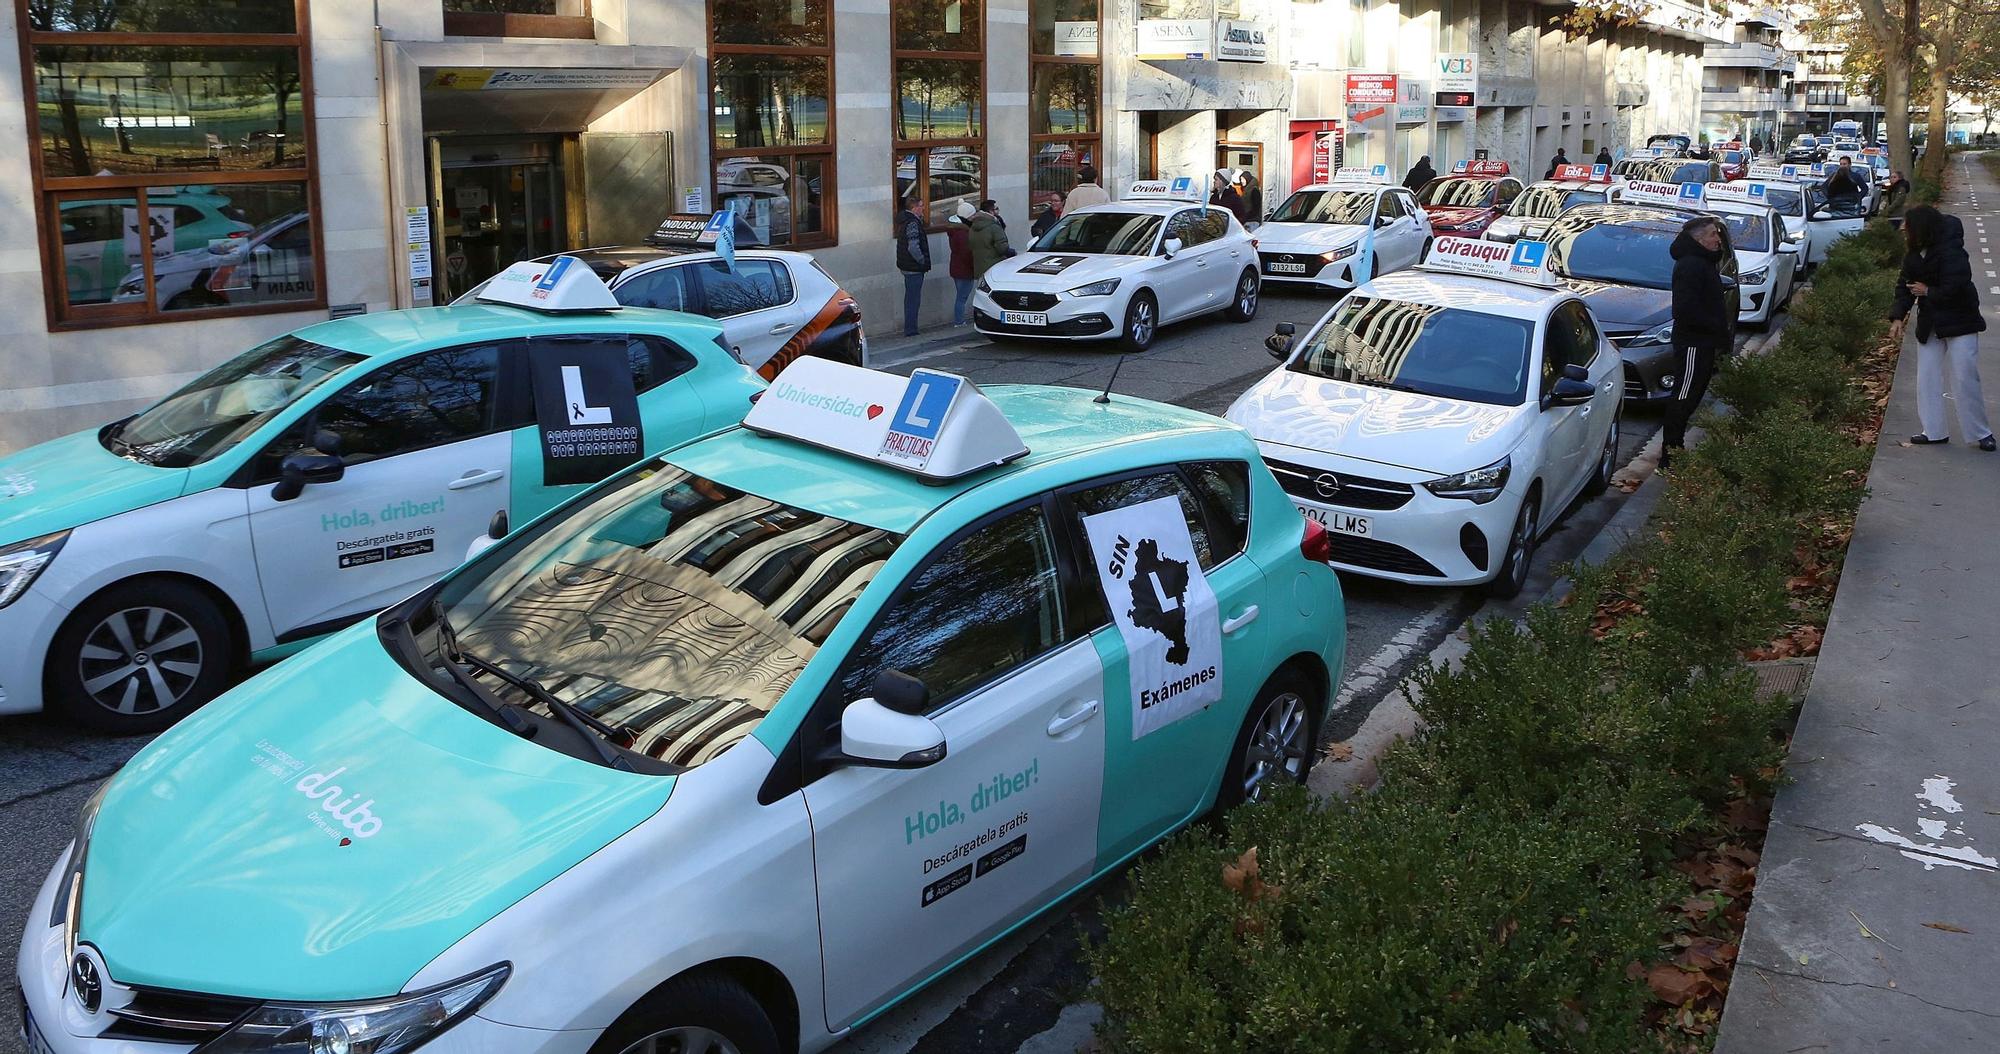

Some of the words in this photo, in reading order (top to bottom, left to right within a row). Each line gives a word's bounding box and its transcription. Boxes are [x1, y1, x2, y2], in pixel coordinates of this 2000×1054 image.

[1152, 25, 1194, 37] ASENA
[1348, 88, 1394, 97] CONDUCTORES
[1594, 166, 1602, 174] L
[1132, 183, 1167, 193] Orvina
[1175, 181, 1184, 190] L
[1629, 180, 1679, 197] Cirauqui
[1685, 185, 1696, 197] L
[1708, 182, 1747, 193] Cirauqui
[1751, 185, 1761, 195] L
[660, 219, 708, 231] INDURAIN
[711, 214, 722, 229] L
[1436, 237, 1511, 263] Cirauqui
[1518, 245, 1534, 263] L
[1272, 263, 1289, 271] 2132
[1290, 264, 1304, 272] LSG
[1006, 313, 1026, 323] 8894
[1028, 315, 1044, 324] LPF
[561, 365, 613, 426] L
[775, 381, 868, 419] Universidad
[905, 382, 930, 428] L
[883, 430, 934, 459] PRACTICAS
[320, 508, 376, 532] Hola,
[380, 495, 445, 522] driber!
[1334, 513, 1367, 534] LMS
[336, 531, 405, 551] Descárgatela
[407, 525, 435, 541] gratis
[1108, 534, 1131, 580] SIN
[1148, 571, 1179, 614] L
[1140, 665, 1216, 711] Exámenes
[295, 766, 383, 839] dribo
[904, 800, 966, 846] Hola,
[970, 757, 1039, 814] driber!
[923, 828, 996, 875] Descárgatela
[999, 811, 1029, 838] gratis
[935, 884, 951, 898] App
[951, 874, 969, 890] Store
